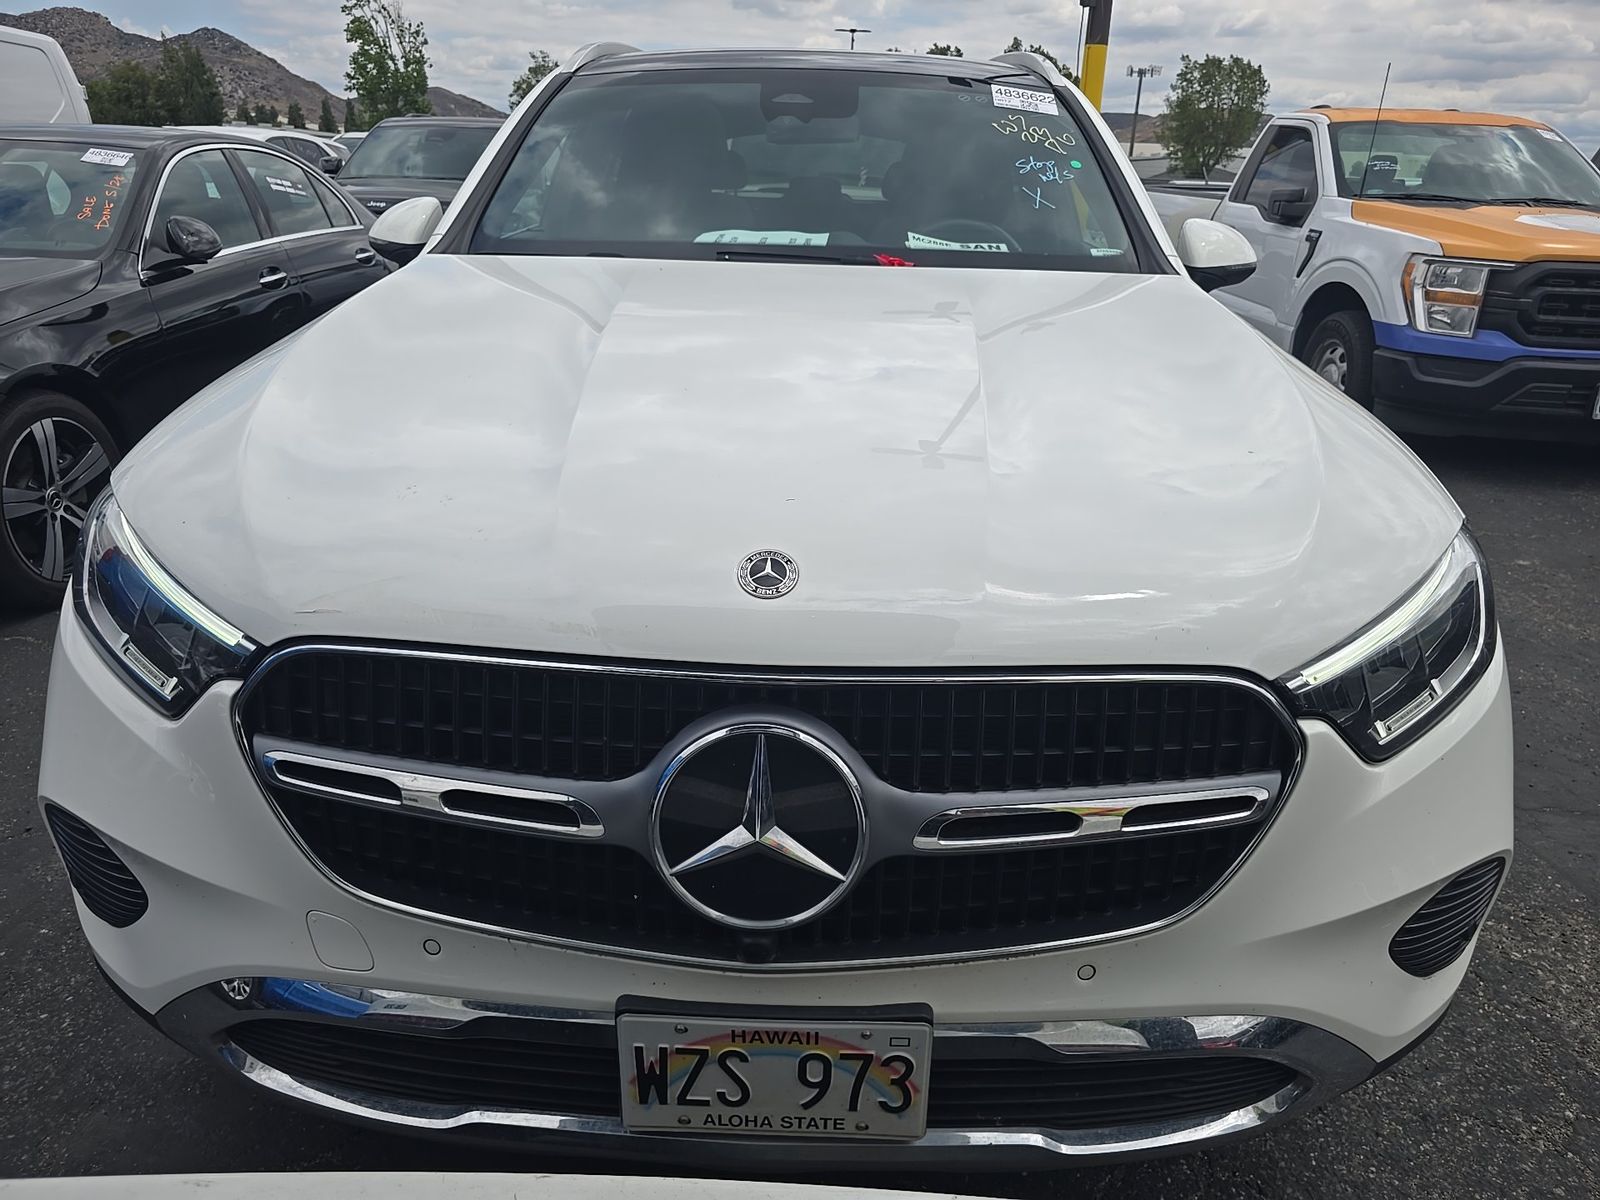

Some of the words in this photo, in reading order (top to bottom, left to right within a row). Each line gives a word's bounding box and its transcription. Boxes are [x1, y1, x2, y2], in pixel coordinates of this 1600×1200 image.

[995, 87, 1054, 104] 4836622
[76, 195, 97, 220] SALE
[366, 200, 387, 208] Jeep
[959, 243, 1002, 251] SAN
[750, 551, 788, 562] MERCEDES
[731, 1029, 820, 1046] HAWAII
[632, 1045, 752, 1109] WZS
[797, 1051, 917, 1115] 973
[703, 1113, 773, 1129] ALOHA
[781, 1115, 846, 1131] STATE
